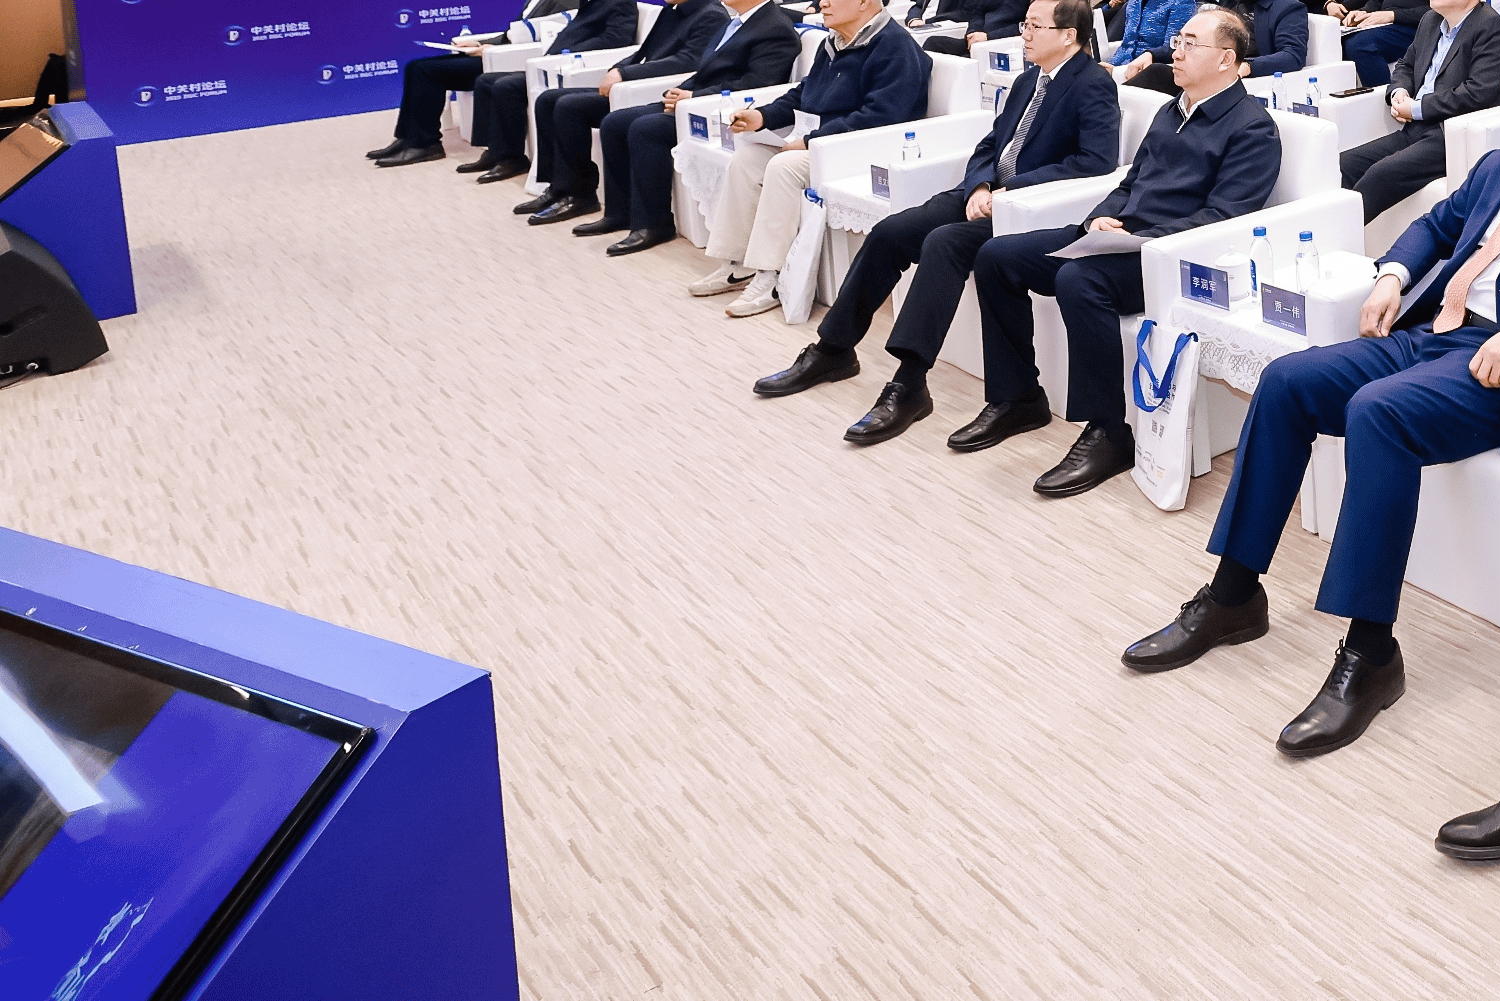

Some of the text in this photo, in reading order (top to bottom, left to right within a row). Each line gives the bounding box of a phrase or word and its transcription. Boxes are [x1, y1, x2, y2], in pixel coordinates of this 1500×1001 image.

[418, 5, 472, 19] 中关村论坛
[250, 21, 311, 35] 中关村论坛
[342, 59, 399, 74] 中关村论坛
[163, 79, 228, 95] 中关村论坛
